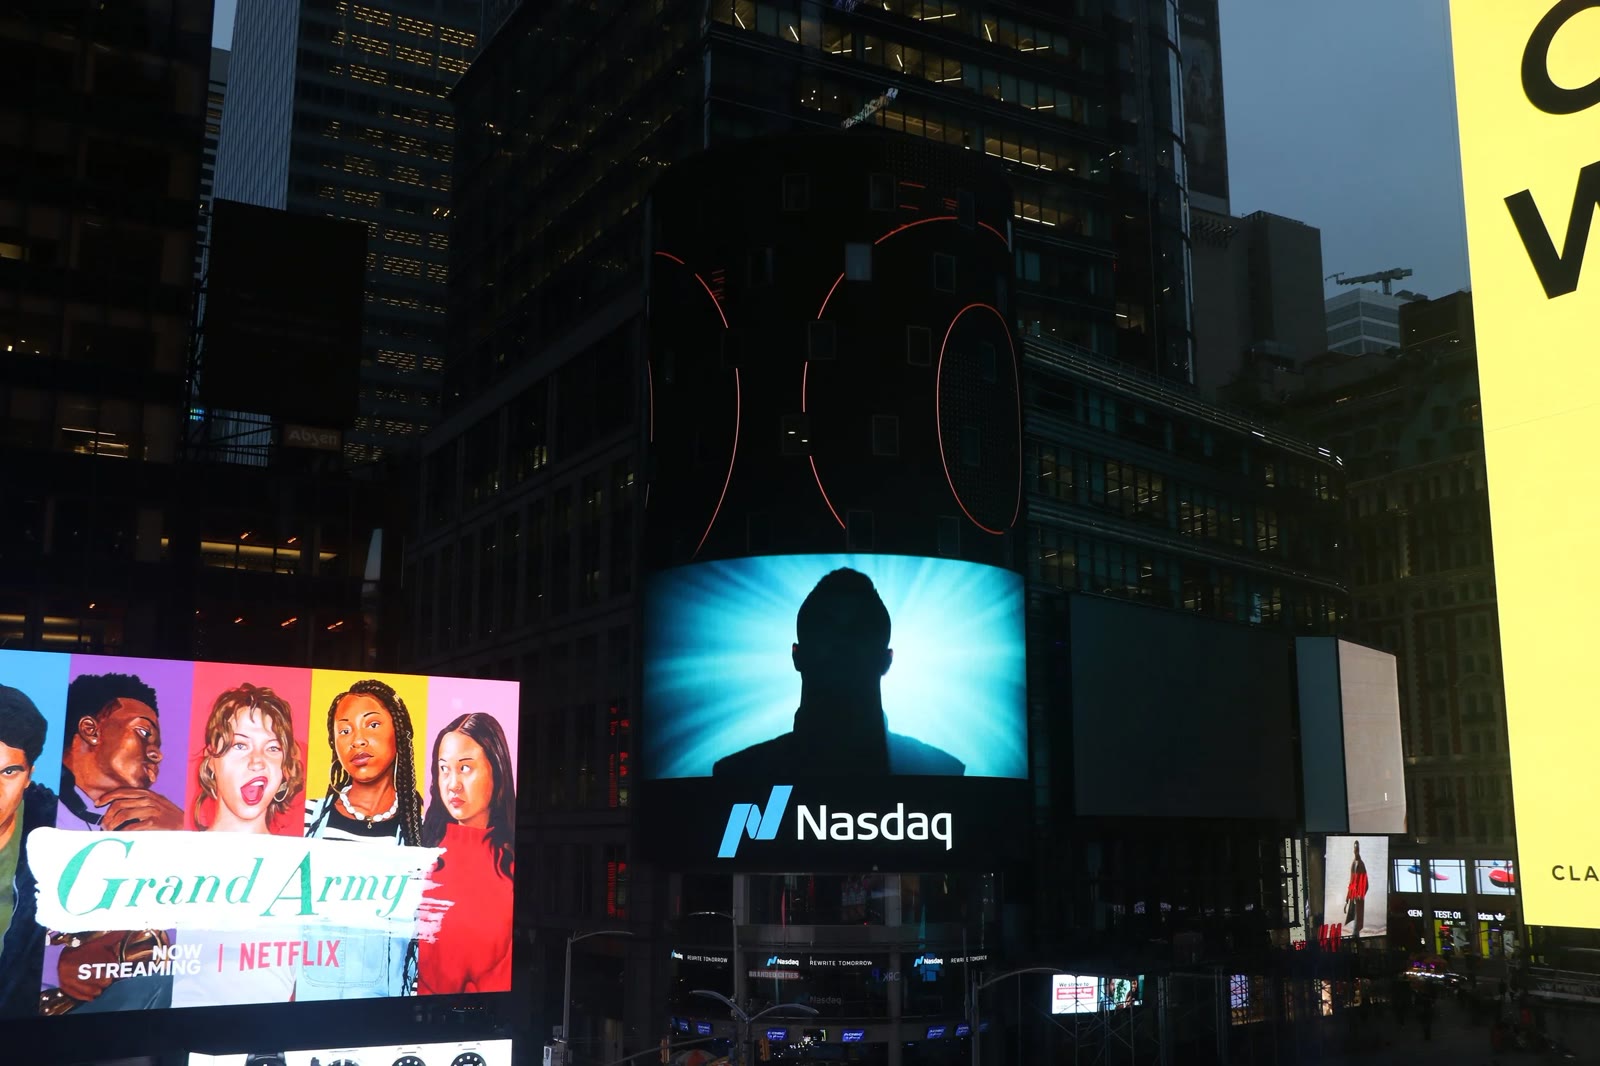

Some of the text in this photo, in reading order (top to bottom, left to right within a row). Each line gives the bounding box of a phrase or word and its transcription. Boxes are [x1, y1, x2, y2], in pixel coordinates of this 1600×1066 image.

[288, 429, 337, 447] Absen
[797, 802, 953, 851] Nasdaq
[57, 838, 417, 918] Grand Army
[152, 943, 203, 962] NOW
[239, 939, 341, 971] NETFLIX
[777, 957, 799, 967] Nasdaq
[924, 957, 943, 966] Nasdaq
[77, 959, 202, 980] STREAMING
